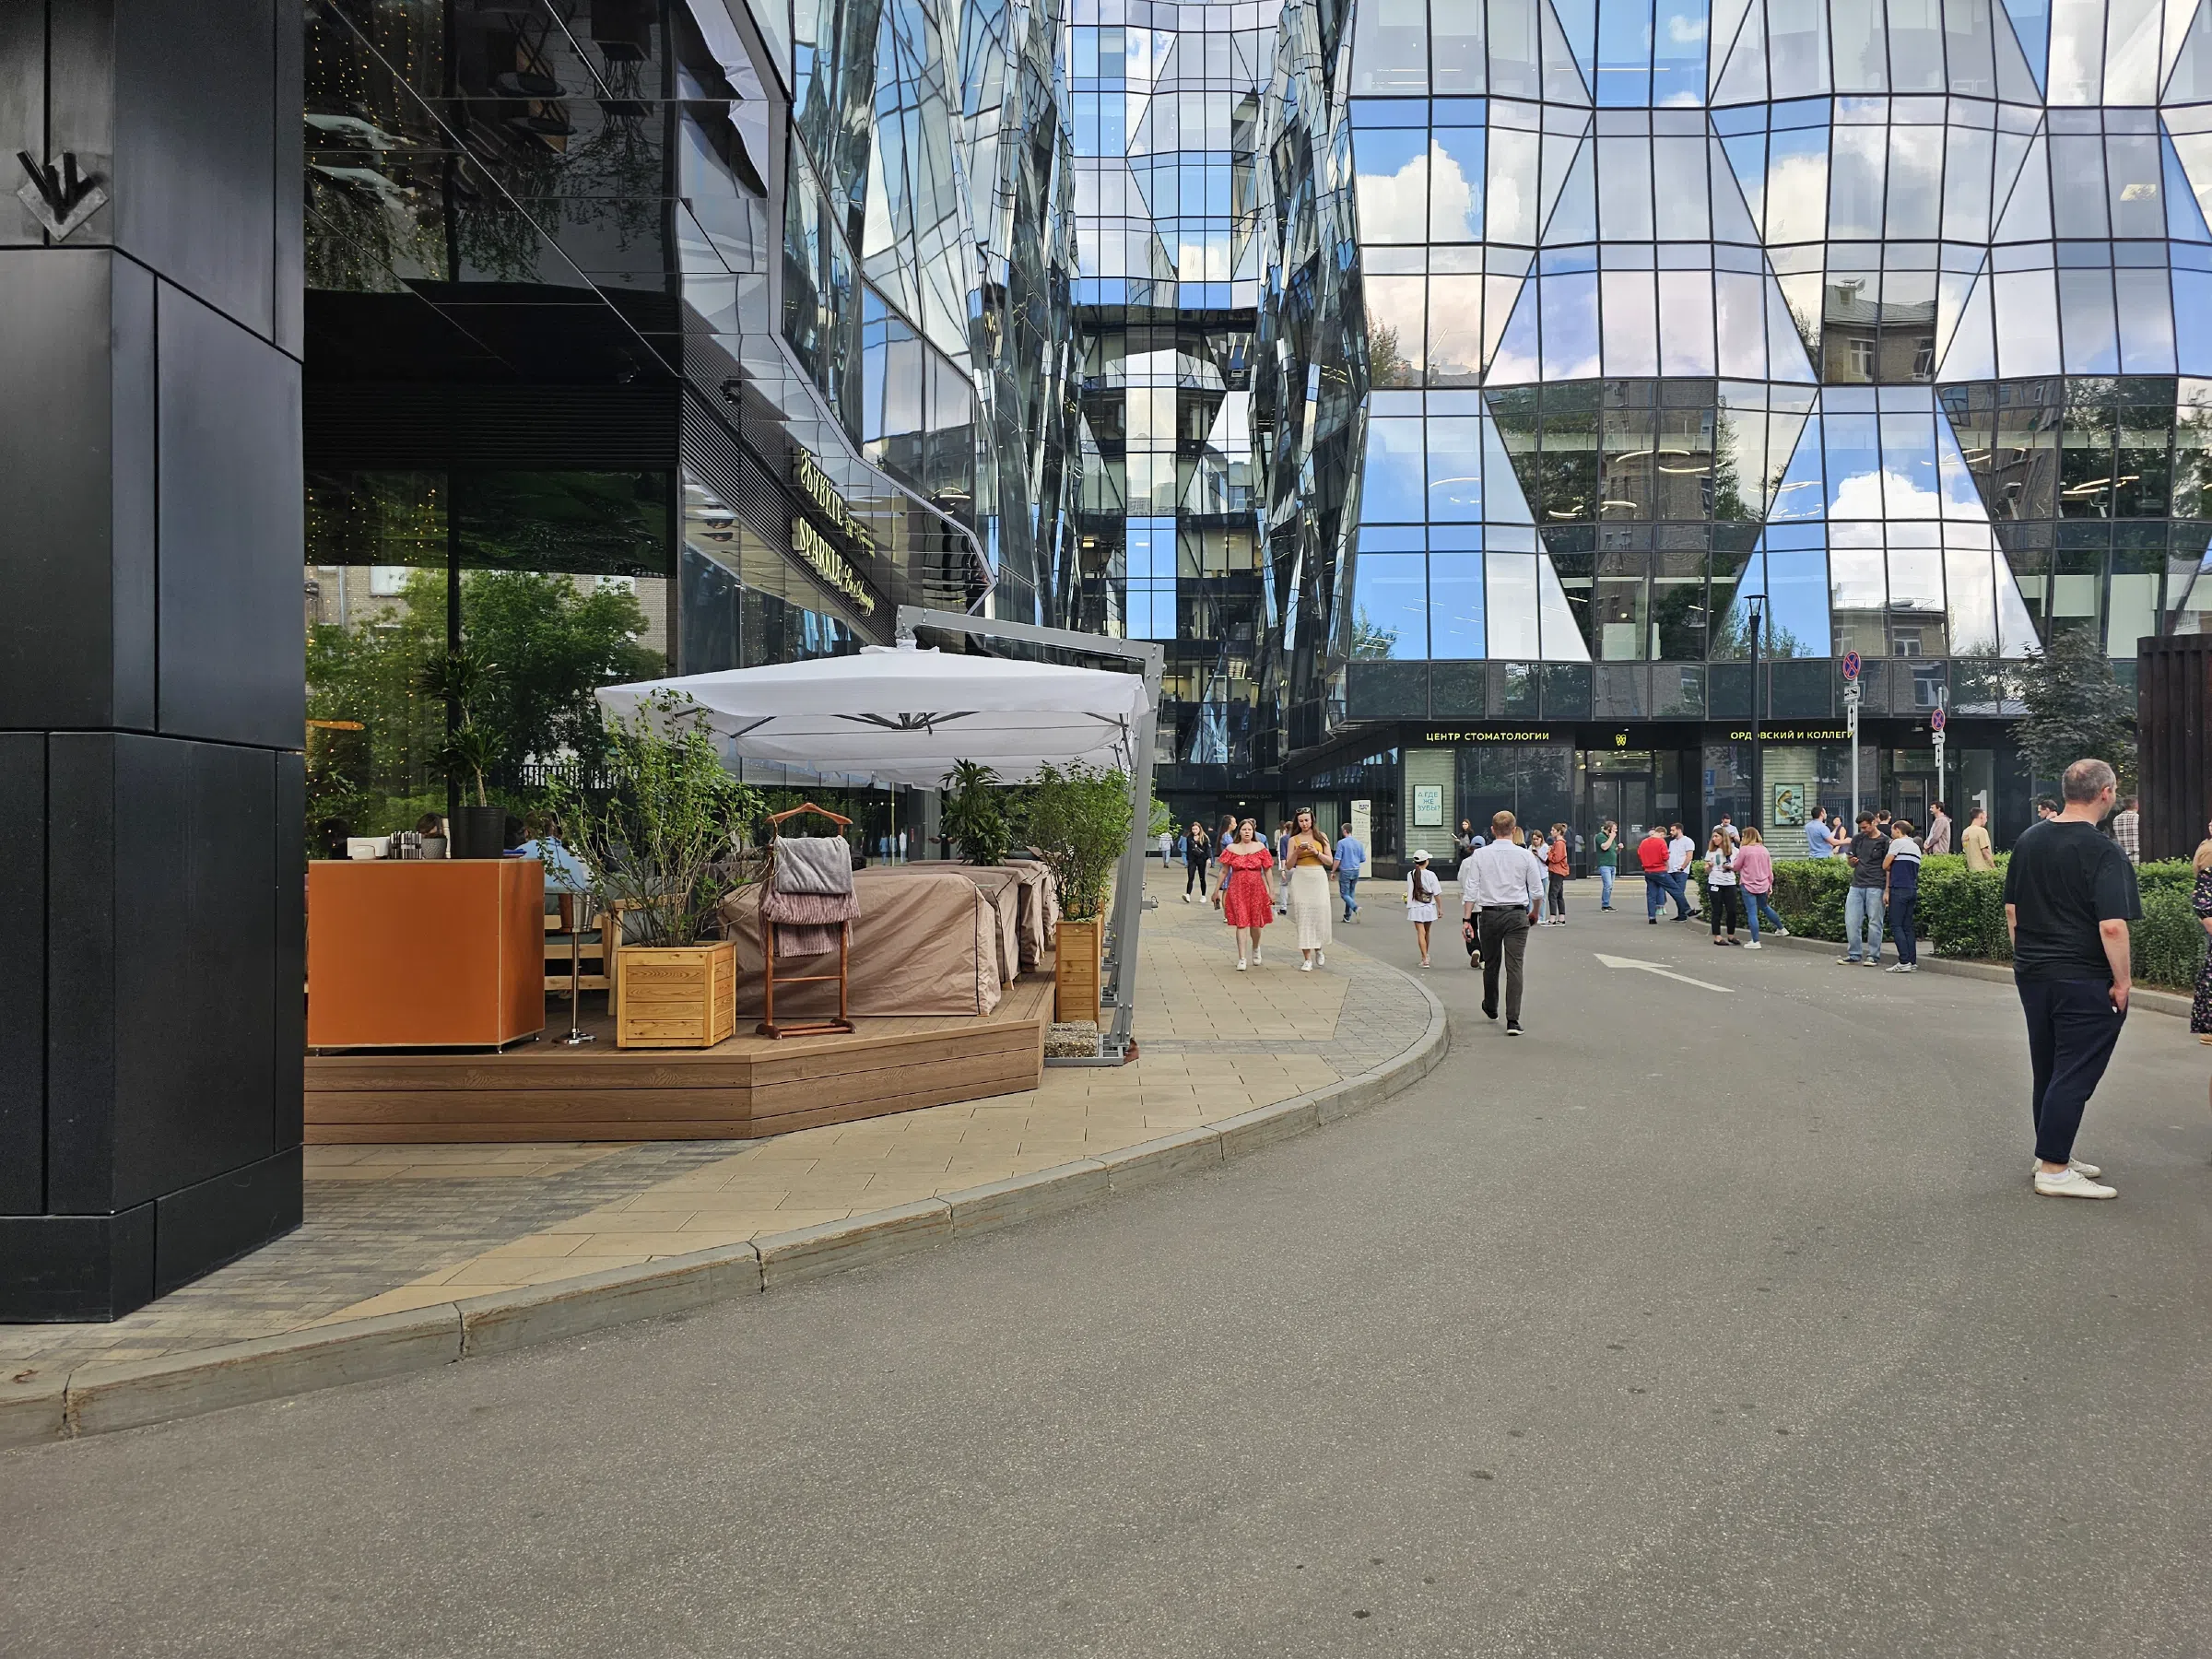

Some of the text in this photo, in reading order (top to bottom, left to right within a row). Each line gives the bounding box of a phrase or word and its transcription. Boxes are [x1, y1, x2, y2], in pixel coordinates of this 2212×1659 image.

[799, 516, 842, 586] SPARKLE
[1426, 732, 1549, 742] ЦЕНТР СТОМАТОЛОГИИ
[1730, 730, 1794, 740] ОРДВСКИЙ
[1797, 731, 1805, 739] И
[1972, 789, 1987, 812] 1
